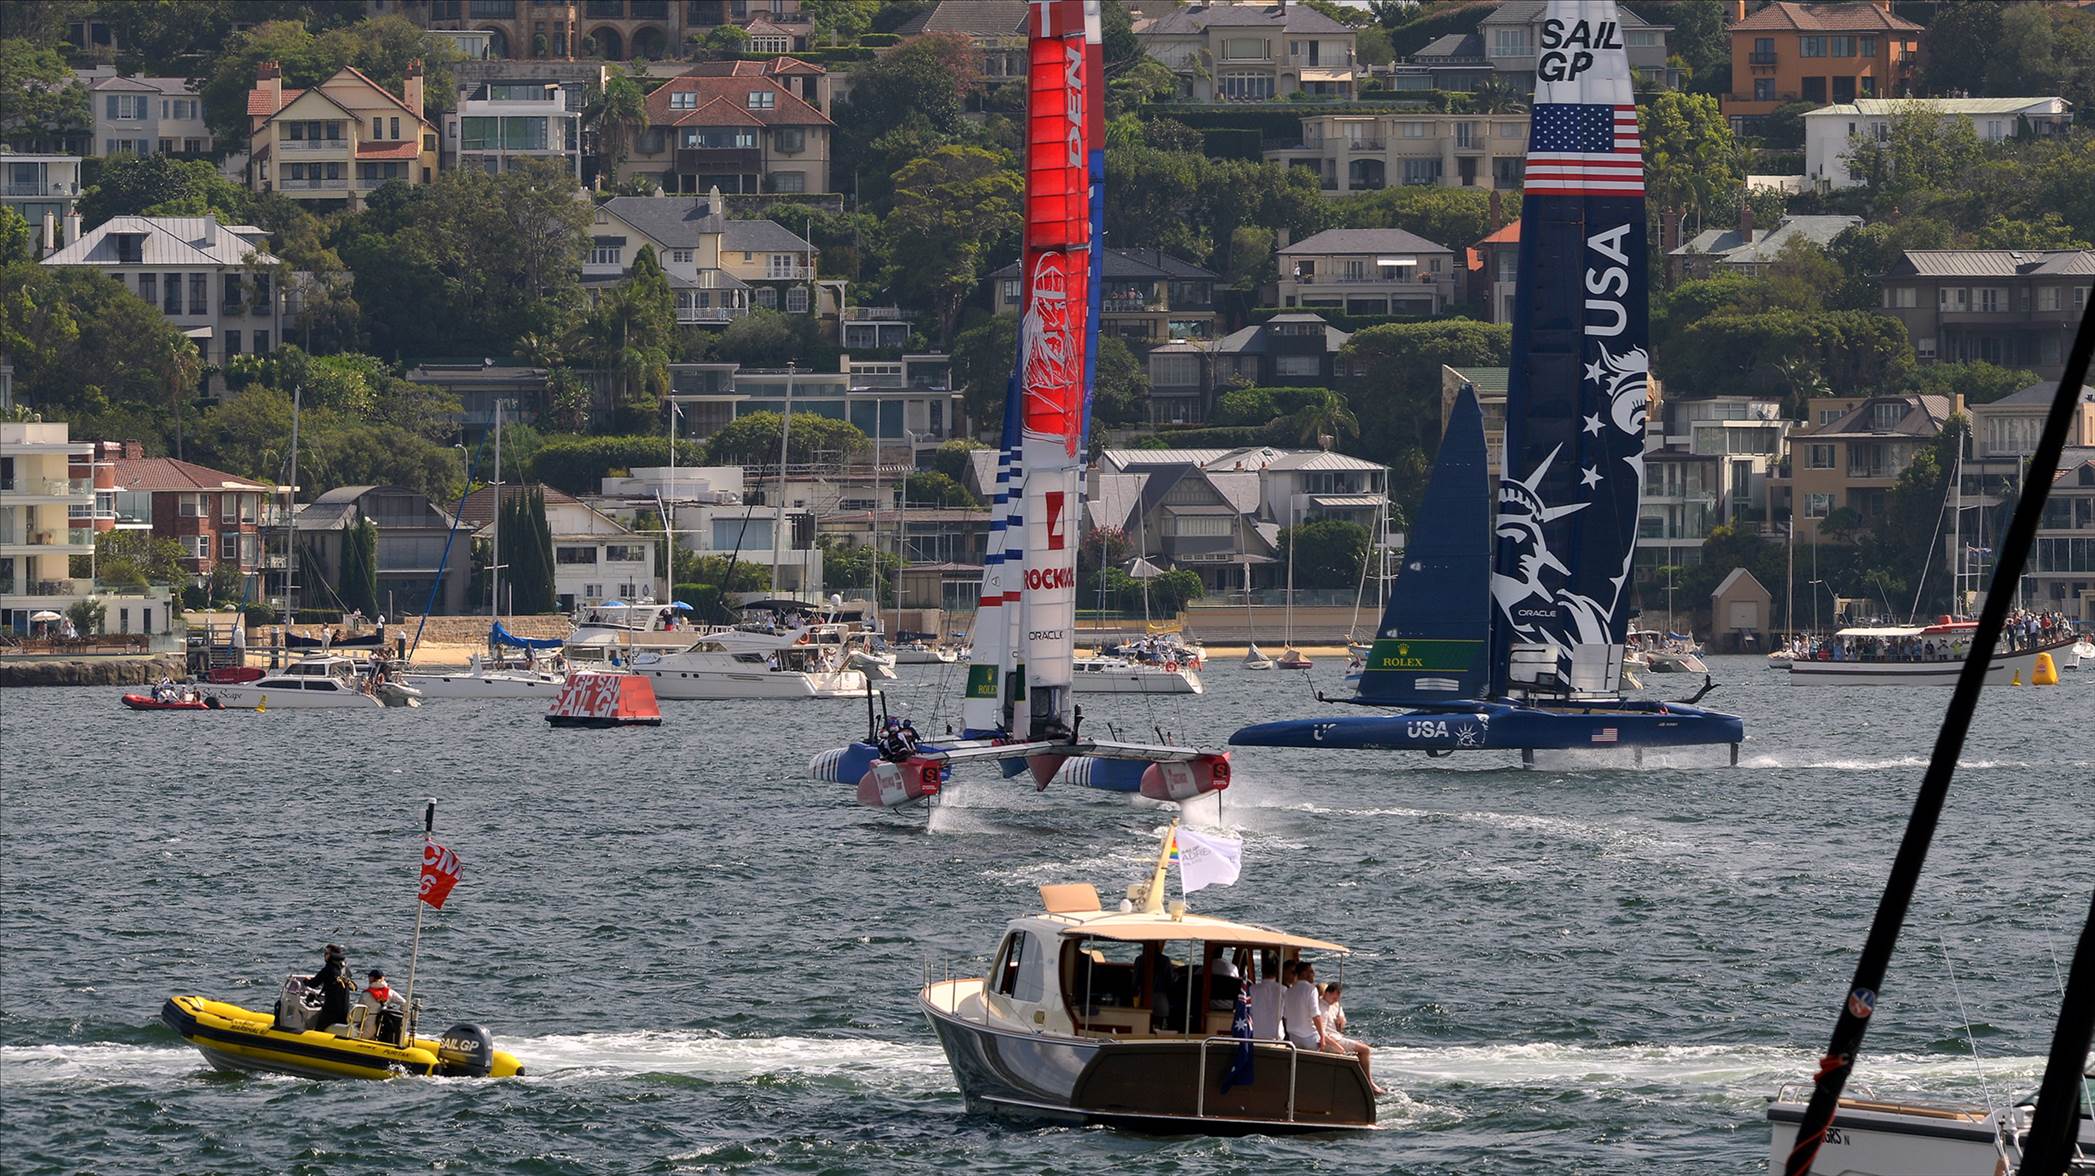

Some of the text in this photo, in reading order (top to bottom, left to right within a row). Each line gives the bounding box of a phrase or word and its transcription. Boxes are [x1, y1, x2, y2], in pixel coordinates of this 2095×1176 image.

[1541, 19, 1623, 50] SAIL
[1538, 51, 1594, 82] GP
[1065, 46, 1082, 169] DEN
[1584, 223, 1631, 337] USA
[1518, 609, 1557, 618] ORACLE
[1383, 657, 1424, 667] ROLEX
[1408, 721, 1449, 739] USA
[460, 1039, 480, 1052] GP
[1843, 1135, 1850, 1146] N
